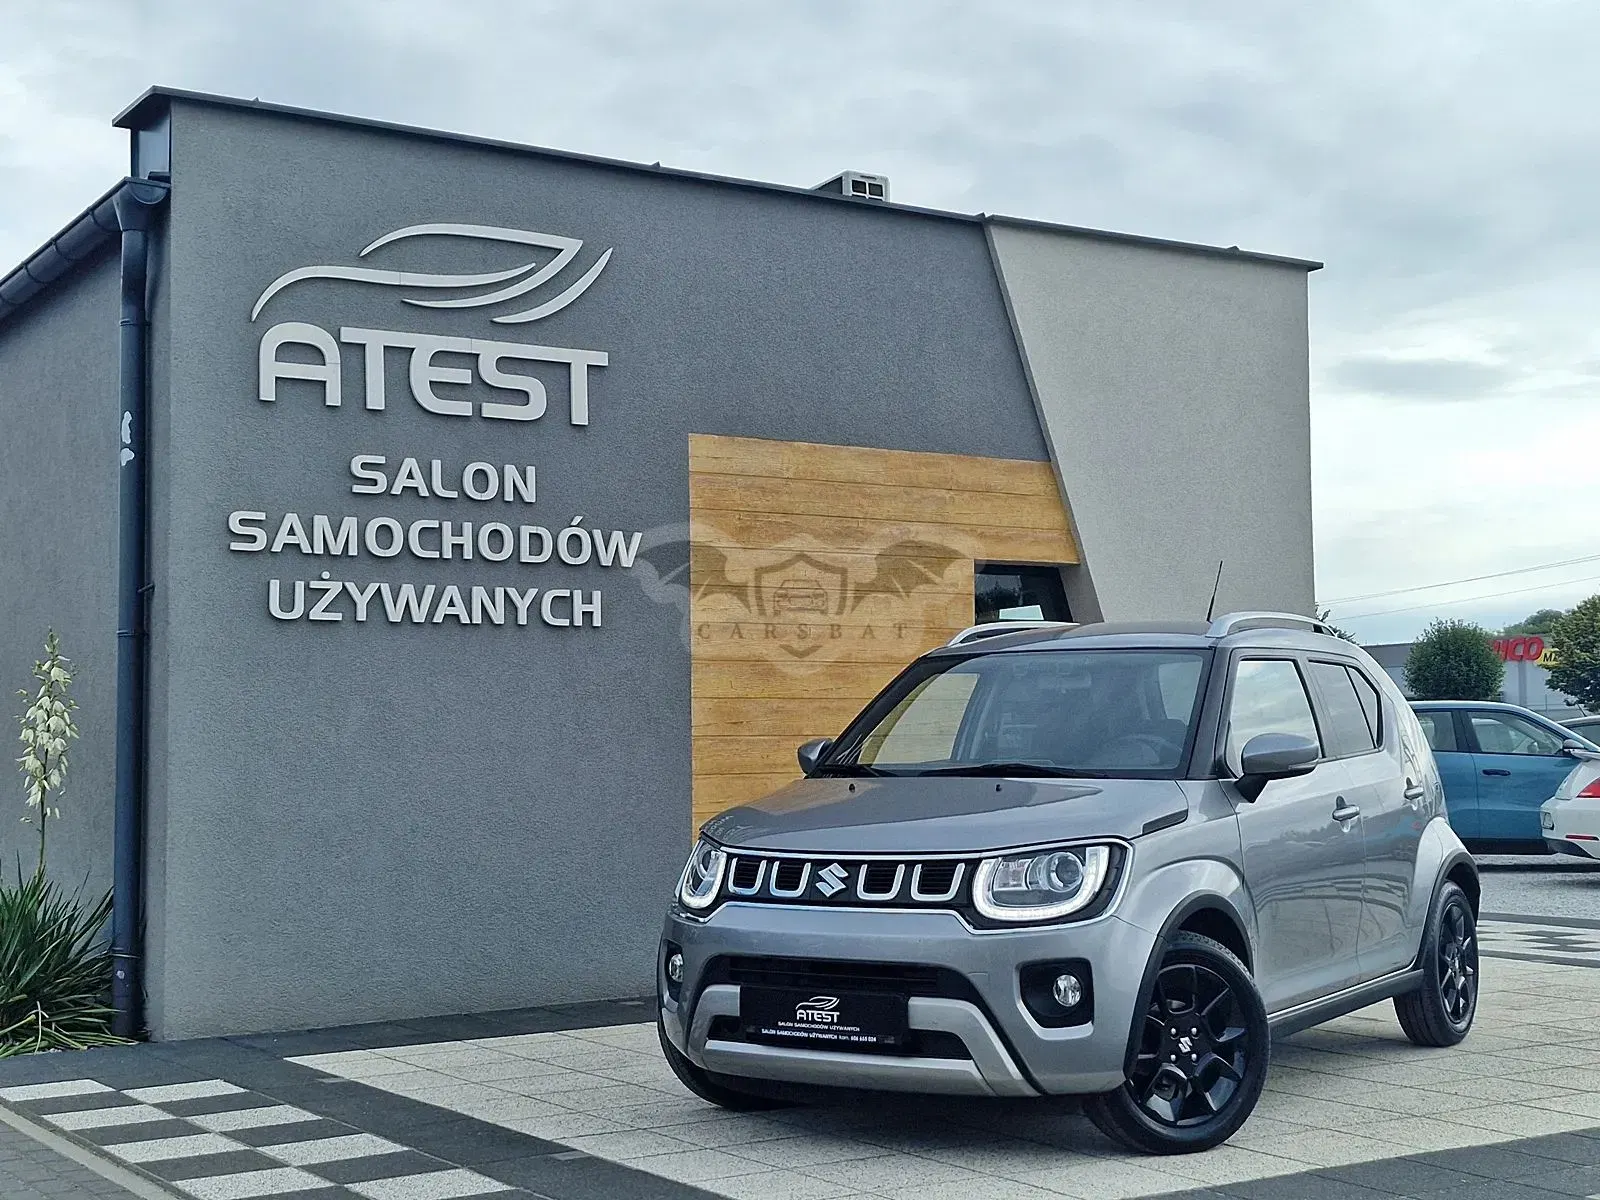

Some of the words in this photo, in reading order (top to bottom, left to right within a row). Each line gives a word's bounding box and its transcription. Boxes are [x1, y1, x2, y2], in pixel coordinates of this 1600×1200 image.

[258, 321, 609, 426] ATEST
[349, 455, 537, 503] SALON
[227, 510, 643, 569] SAMOCHODÓW
[267, 571, 602, 627] UŻYWANYCH
[796, 1009, 840, 1023] ATEST
